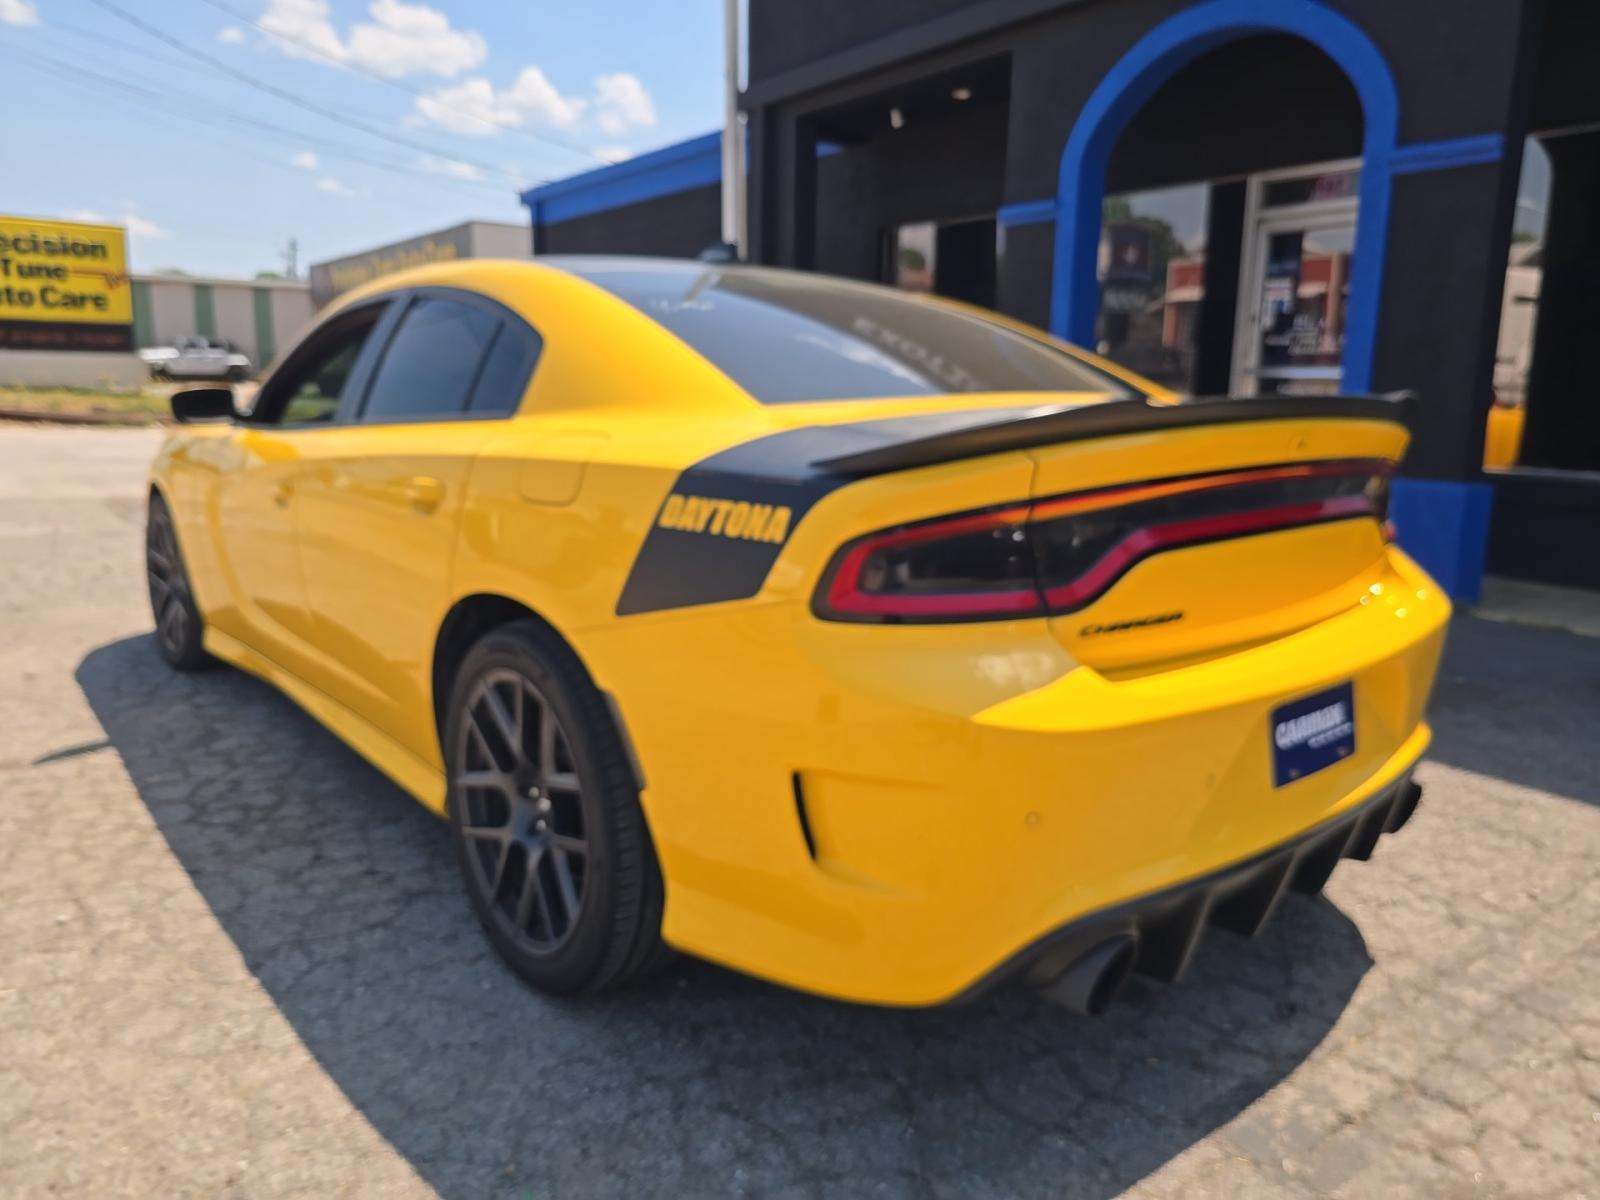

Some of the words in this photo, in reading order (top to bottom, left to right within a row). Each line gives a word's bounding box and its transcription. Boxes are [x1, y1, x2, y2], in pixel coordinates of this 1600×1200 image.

[0, 258, 68, 280] Tune
[40, 286, 107, 311] Care
[658, 494, 792, 544] DAYTONA
